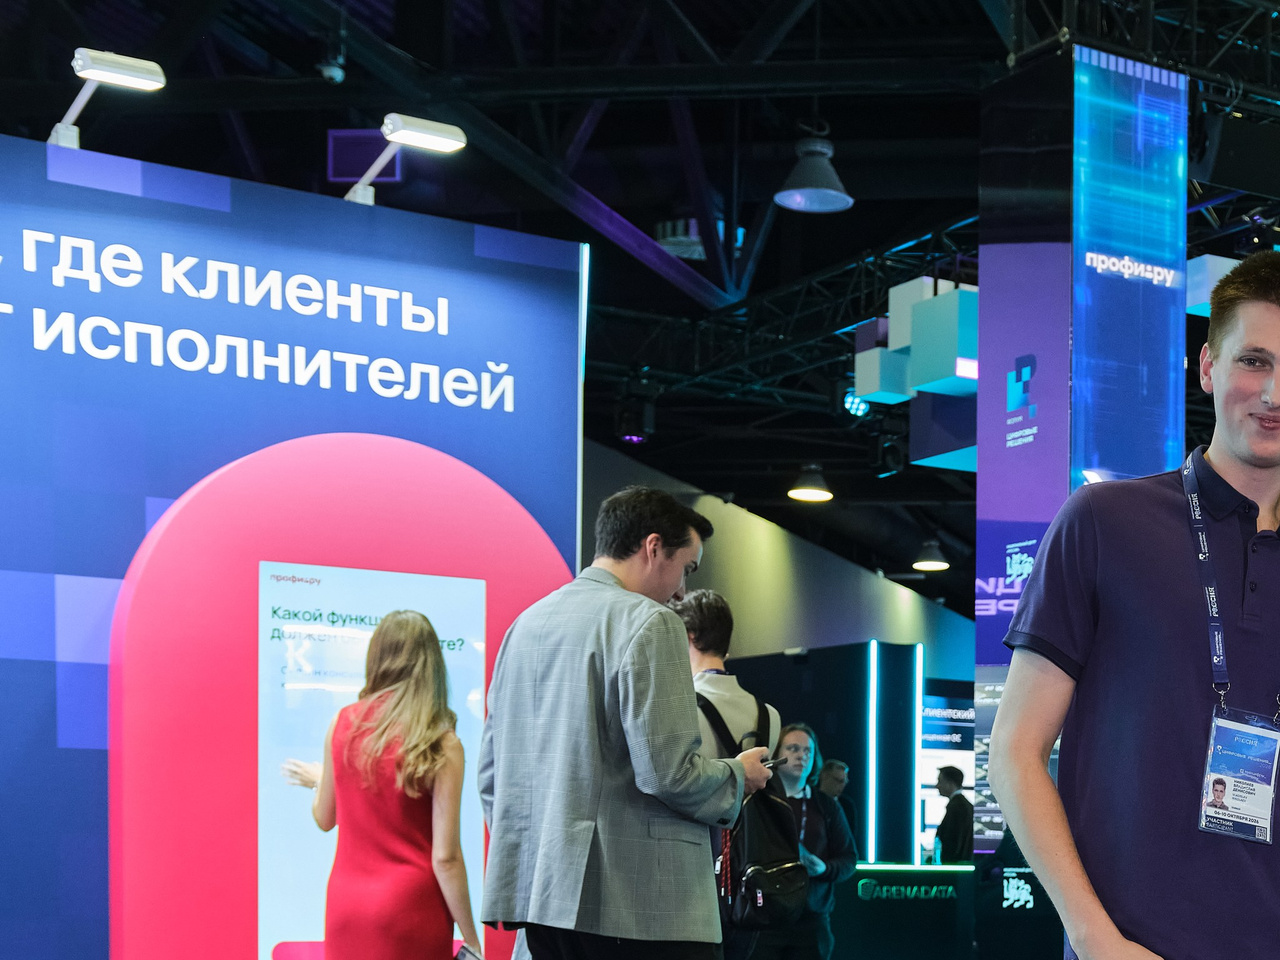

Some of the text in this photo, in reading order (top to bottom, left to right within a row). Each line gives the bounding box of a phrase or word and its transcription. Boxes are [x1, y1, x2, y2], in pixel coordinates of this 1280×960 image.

[22, 228, 450, 336] где клиенты
[32, 306, 516, 413] исполнителей
[271, 606, 383, 628] Какой функц
[872, 885, 957, 900] ARENADATA
